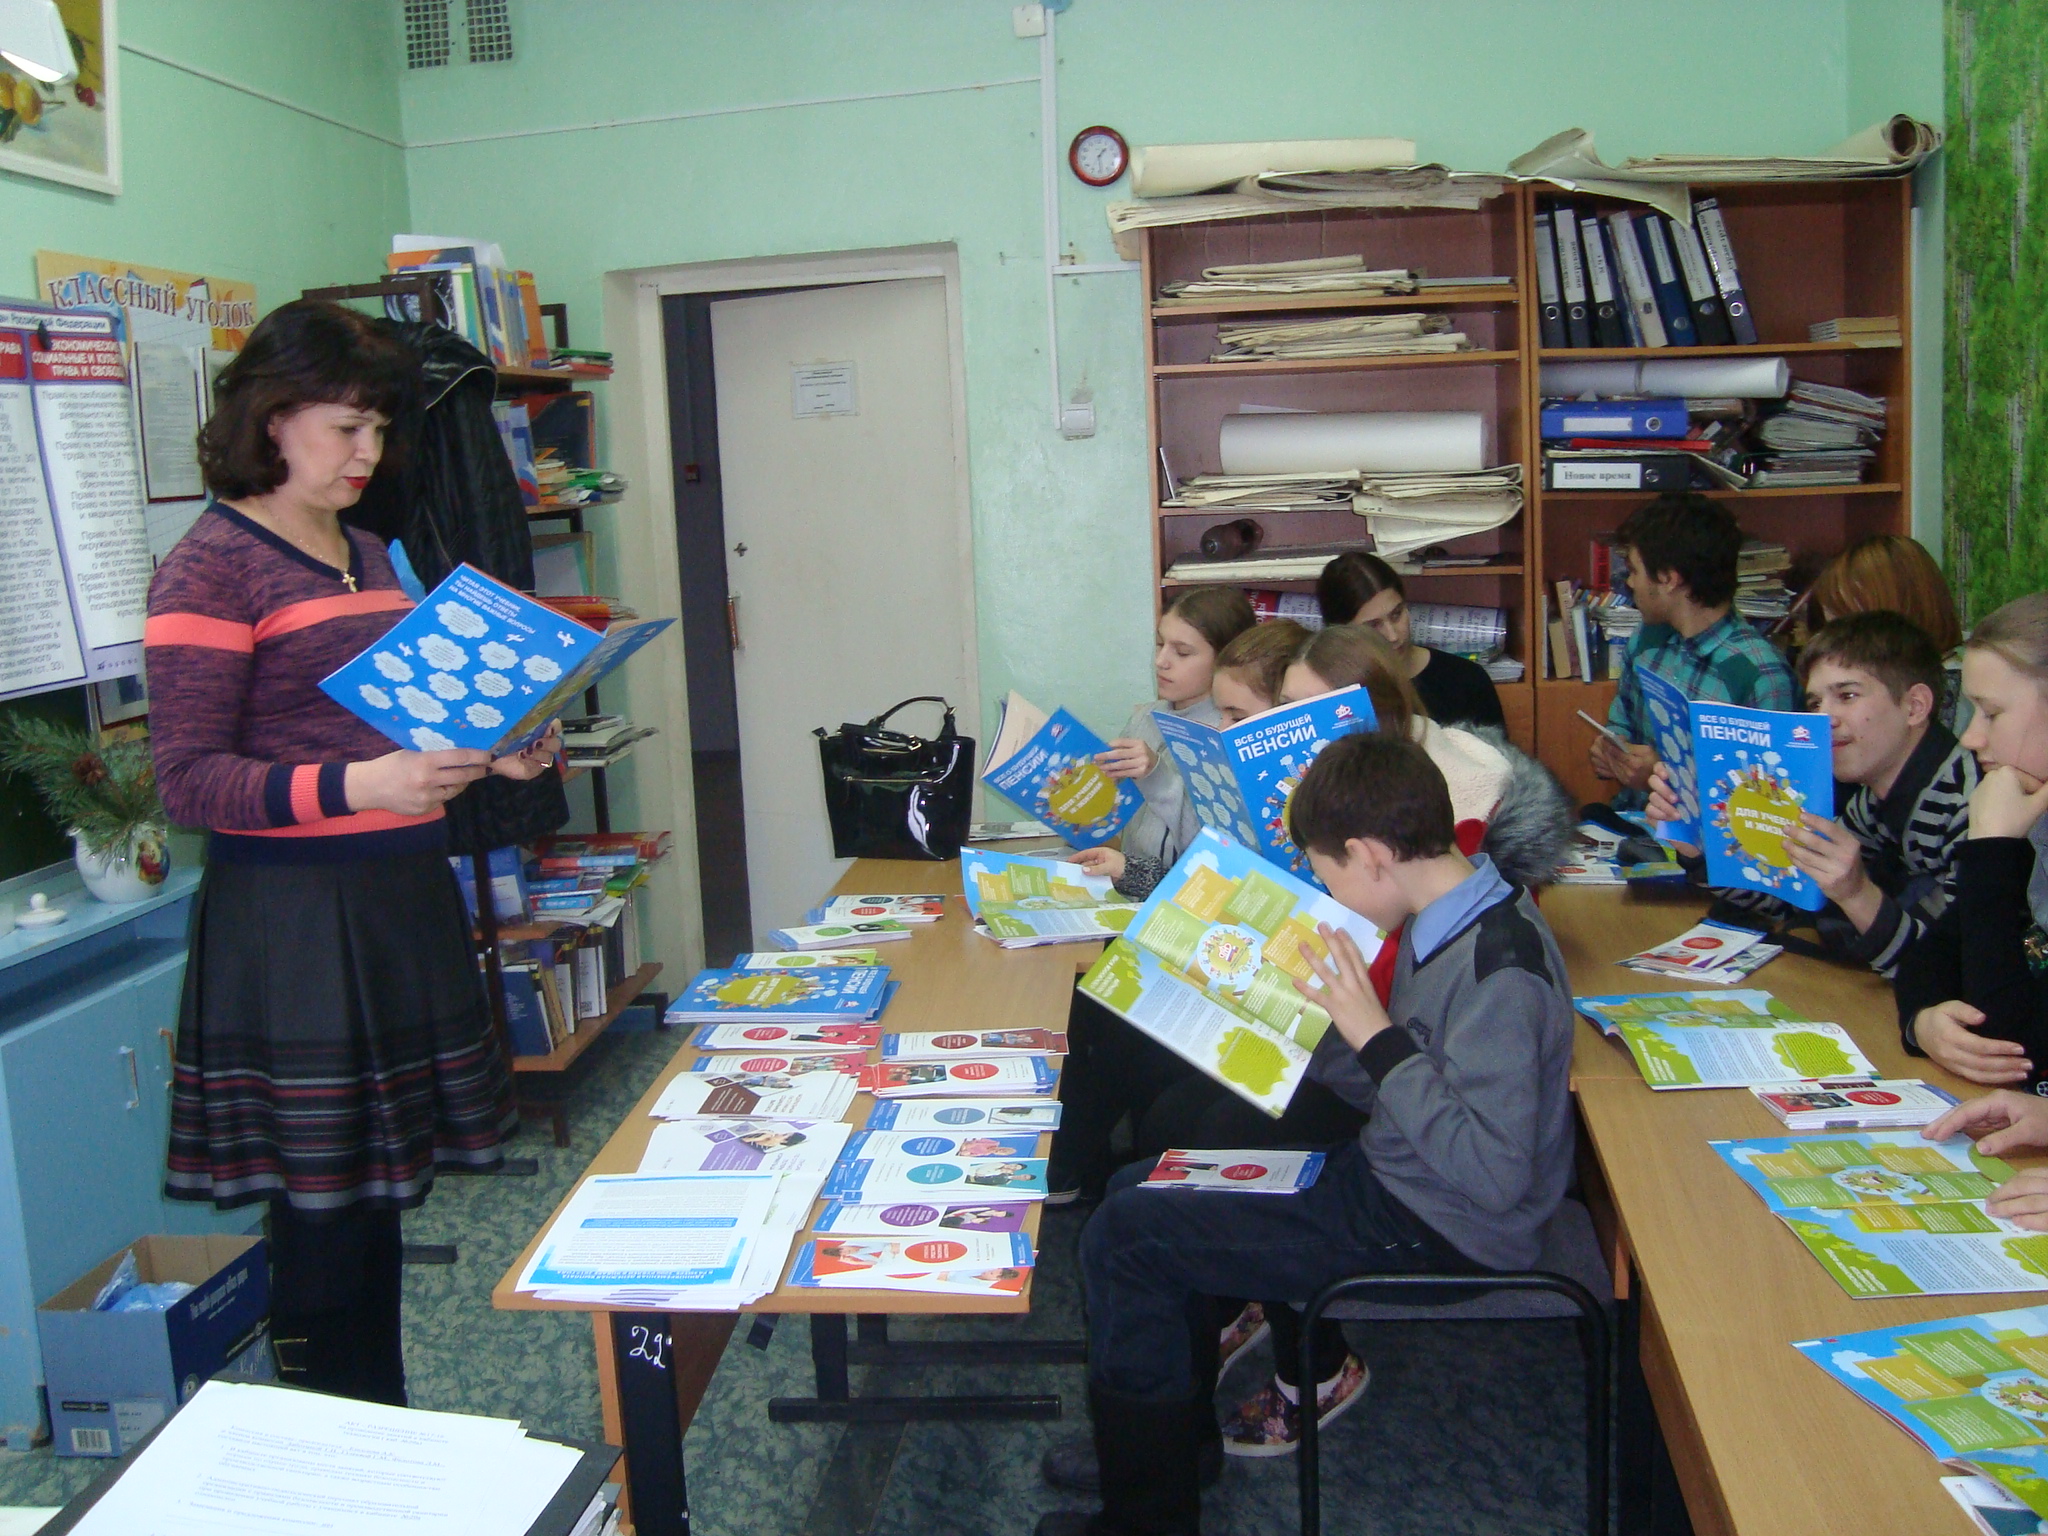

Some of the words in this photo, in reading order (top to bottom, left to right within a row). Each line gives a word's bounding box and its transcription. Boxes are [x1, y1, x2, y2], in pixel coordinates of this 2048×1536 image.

[48, 276, 176, 317] КЛАССНЫЙ
[186, 296, 256, 328] УГОЛОК
[0, 342, 22, 355] РАВА
[1564, 470, 1597, 481] Новое
[1600, 471, 1632, 482] время
[460, 574, 480, 589] ЧИТАЯ
[479, 586, 496, 598] ЭТОТ
[448, 584, 458, 593] НА
[458, 590, 482, 606] МНОГИЕ
[481, 604, 508, 620] ВАЖНЫЕ
[506, 618, 536, 634] ВОПРОСЫ
[455, 580, 464, 588] ТЫ
[464, 586, 493, 604] НАЙДЕШЬ
[492, 602, 518, 618] ОТВЕТЫ
[1234, 734, 1254, 747] ВСЕ
[1256, 730, 1264, 739] О
[1265, 714, 1312, 736] БУДУЩЕЙ
[1698, 714, 1718, 724] ВСЕ
[1728, 717, 1771, 731] БУДУЩЕЙ
[1238, 724, 1318, 763] ПЕНСИИ
[1700, 724, 1772, 748] ПЕНСИИ
[998, 748, 1050, 790] ПЕНСИИ
[1735, 807, 1758, 819] ДЛЯ
[1744, 820, 1753, 828] И
[841, 967, 869, 994] ПЕНСИИ
